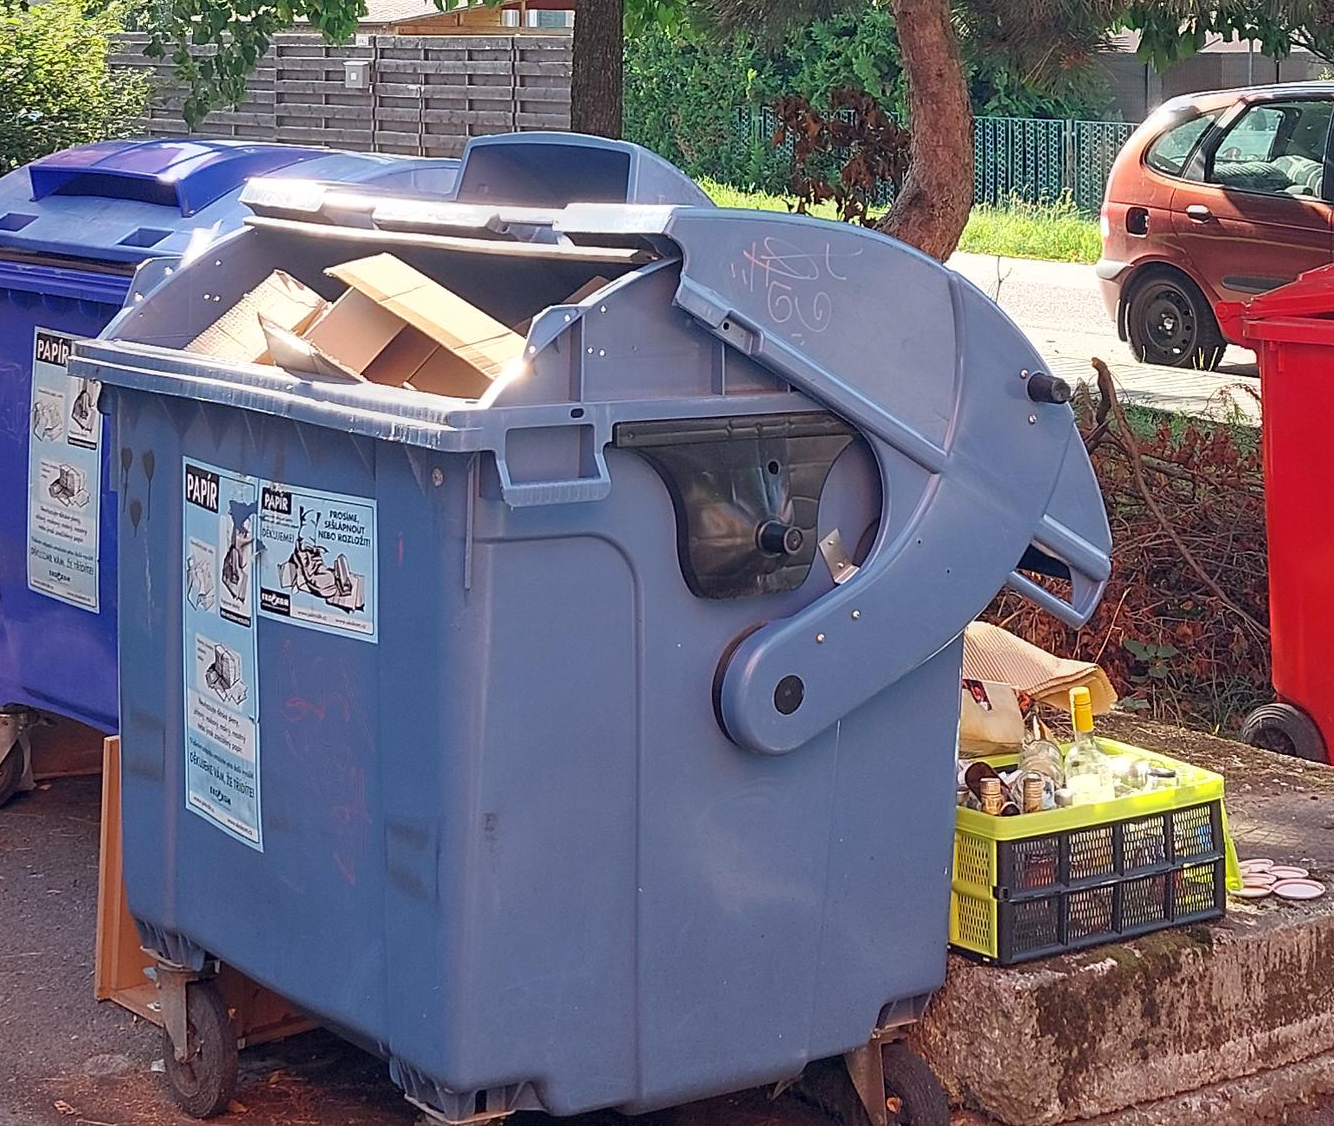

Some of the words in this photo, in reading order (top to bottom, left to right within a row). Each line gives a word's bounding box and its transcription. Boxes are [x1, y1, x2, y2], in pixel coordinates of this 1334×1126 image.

[37, 338, 69, 364] PAPÍR
[187, 472, 217, 510] PAPÍR
[264, 493, 289, 511] PAPÍR
[318, 530, 336, 541] NEBO
[324, 520, 365, 535] SEŠLÁPNOUT
